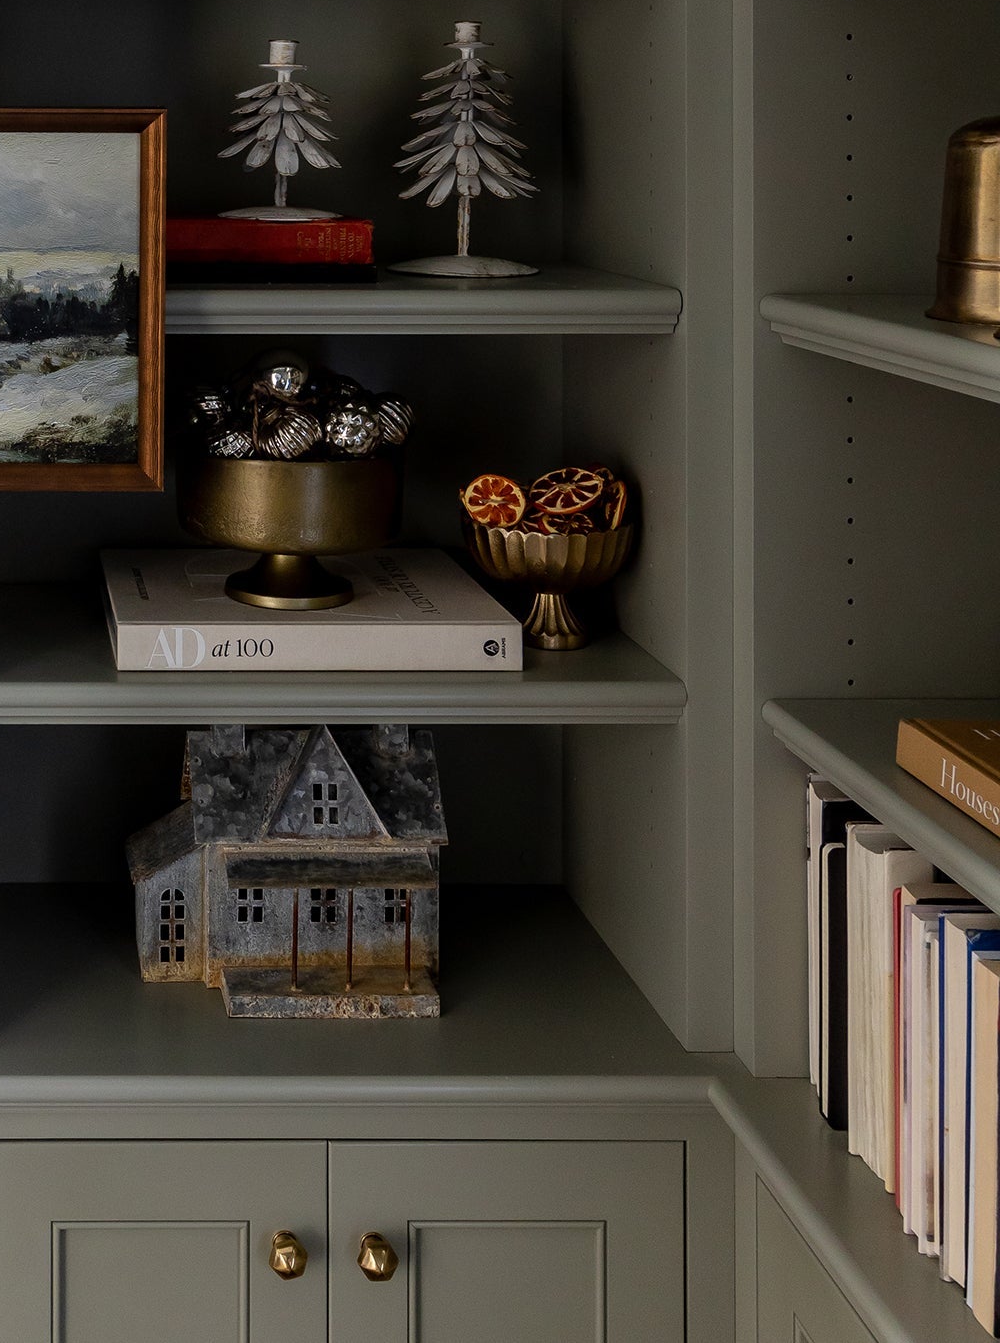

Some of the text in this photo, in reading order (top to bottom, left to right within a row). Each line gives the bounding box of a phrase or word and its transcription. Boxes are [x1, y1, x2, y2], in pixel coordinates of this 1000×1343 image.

[144, 627, 274, 669] AD at 100
[940, 757, 1000, 826] Houses
